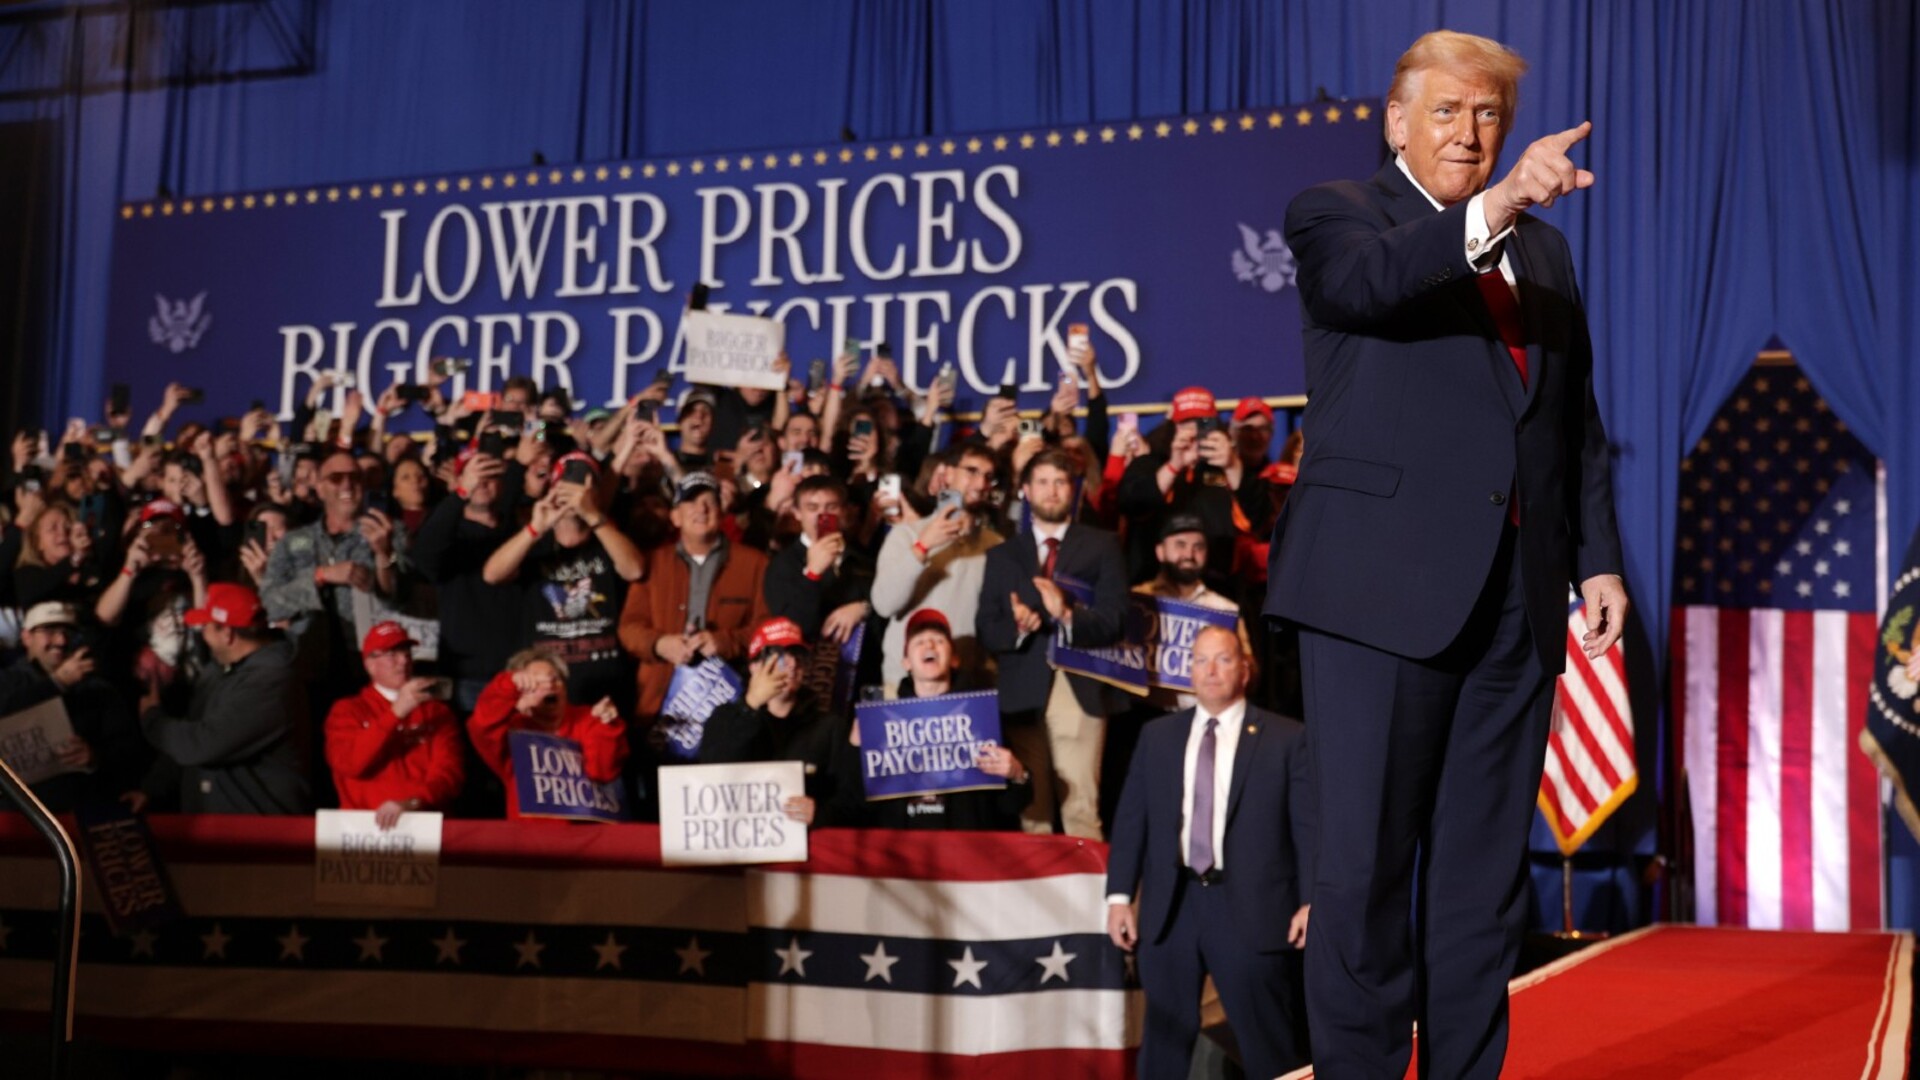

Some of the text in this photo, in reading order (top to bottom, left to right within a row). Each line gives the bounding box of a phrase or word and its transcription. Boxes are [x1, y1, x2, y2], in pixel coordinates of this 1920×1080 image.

[377, 164, 1023, 308] LOWER PRICES
[605, 278, 1141, 408] PCHECKS
[690, 347, 770, 374] PAYCHECK
[884, 713, 975, 748] BIGGER
[528, 744, 583, 777] LOW
[865, 738, 998, 778] PAYCHECK
[533, 776, 621, 814] PRICES
[682, 782, 784, 816] LOWER
[341, 833, 416, 859] BIGGER
[684, 816, 785, 851] PRICES
[89, 823, 136, 916] PRICES
[115, 818, 165, 912] LOWER
[320, 858, 435, 886] PAYCHECKS
